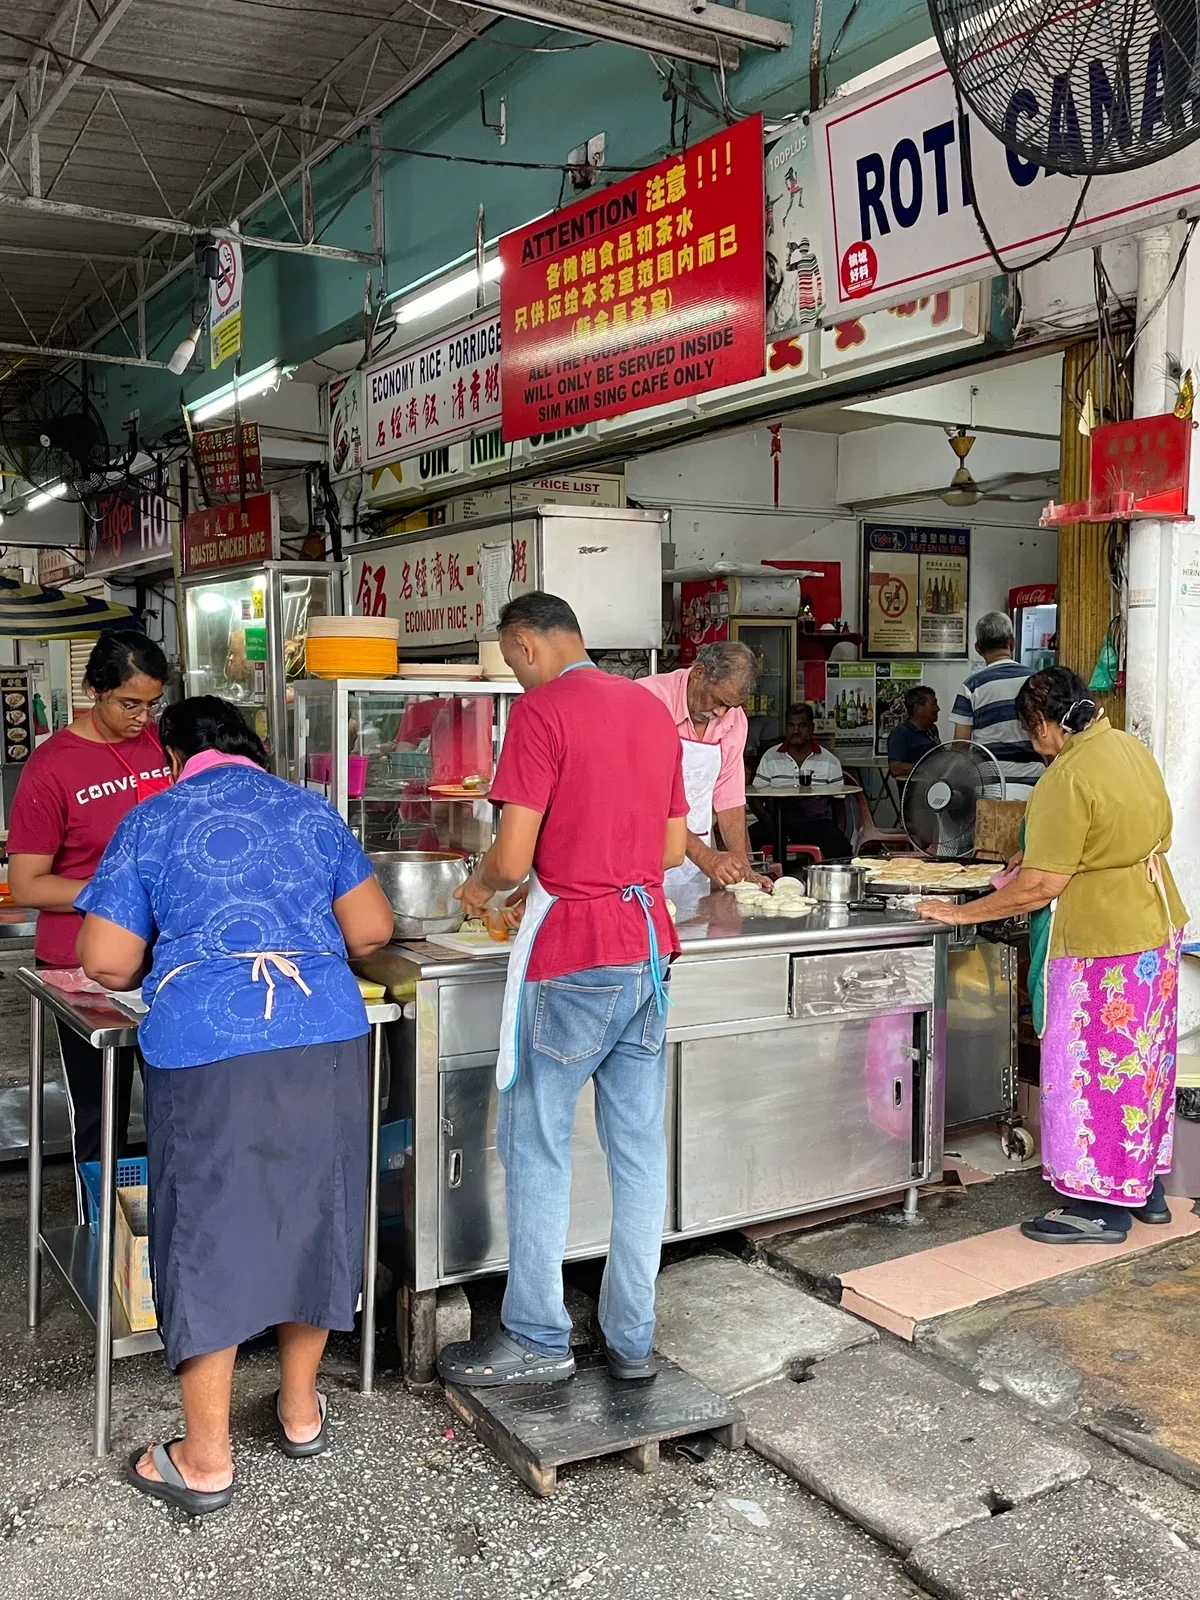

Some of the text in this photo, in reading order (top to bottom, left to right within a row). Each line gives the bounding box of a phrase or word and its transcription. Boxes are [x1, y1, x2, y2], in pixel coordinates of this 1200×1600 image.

[769, 135, 807, 171] 100PLUS
[856, 112, 972, 241] ROTI
[646, 163, 687, 213] 注意
[521, 189, 638, 264] ATTENTION
[372, 322, 501, 404] ECONOMY RICE PORRIDGE
[524, 384, 554, 405] WILL
[558, 370, 593, 396] ONLY
[597, 364, 614, 385] BE
[619, 345, 676, 378] SERVED
[681, 326, 734, 360] INSIDE
[528, 366, 552, 382] ALL
[538, 358, 715, 423] SIM KIM SING CAFÉ ONLY
[532, 479, 600, 493] PRICE LIST
[100, 493, 136, 557] Tiger
[190, 531, 266, 565] ROASTED CHICKEN RICE
[873, 533, 893, 547] Tiger
[405, 608, 445, 633] ECONOMY
[447, 605, 467, 629] RICE
